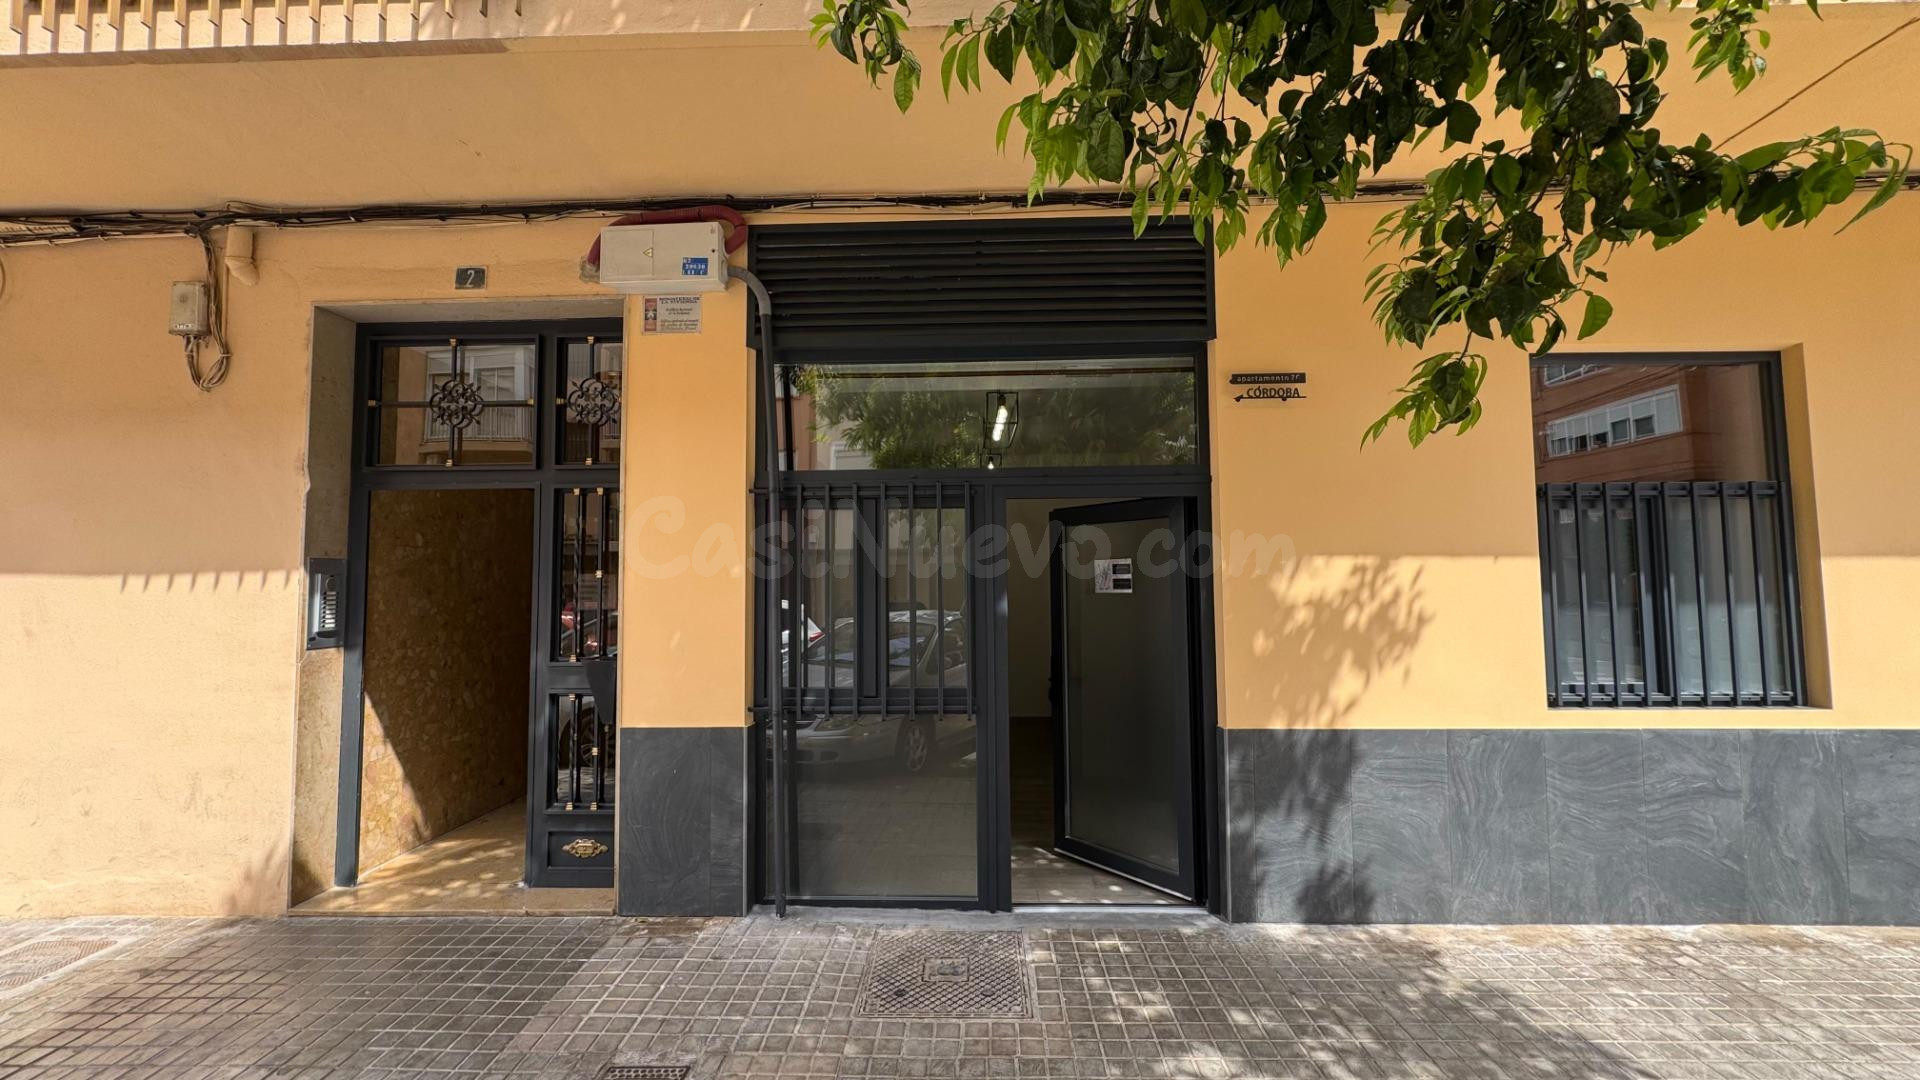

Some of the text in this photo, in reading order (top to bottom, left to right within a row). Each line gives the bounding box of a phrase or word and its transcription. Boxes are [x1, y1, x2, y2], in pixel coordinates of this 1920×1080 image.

[466, 270, 475, 287] 2
[1237, 375, 1289, 383] apartamento
[1246, 386, 1300, 398] CÓRDOBA
